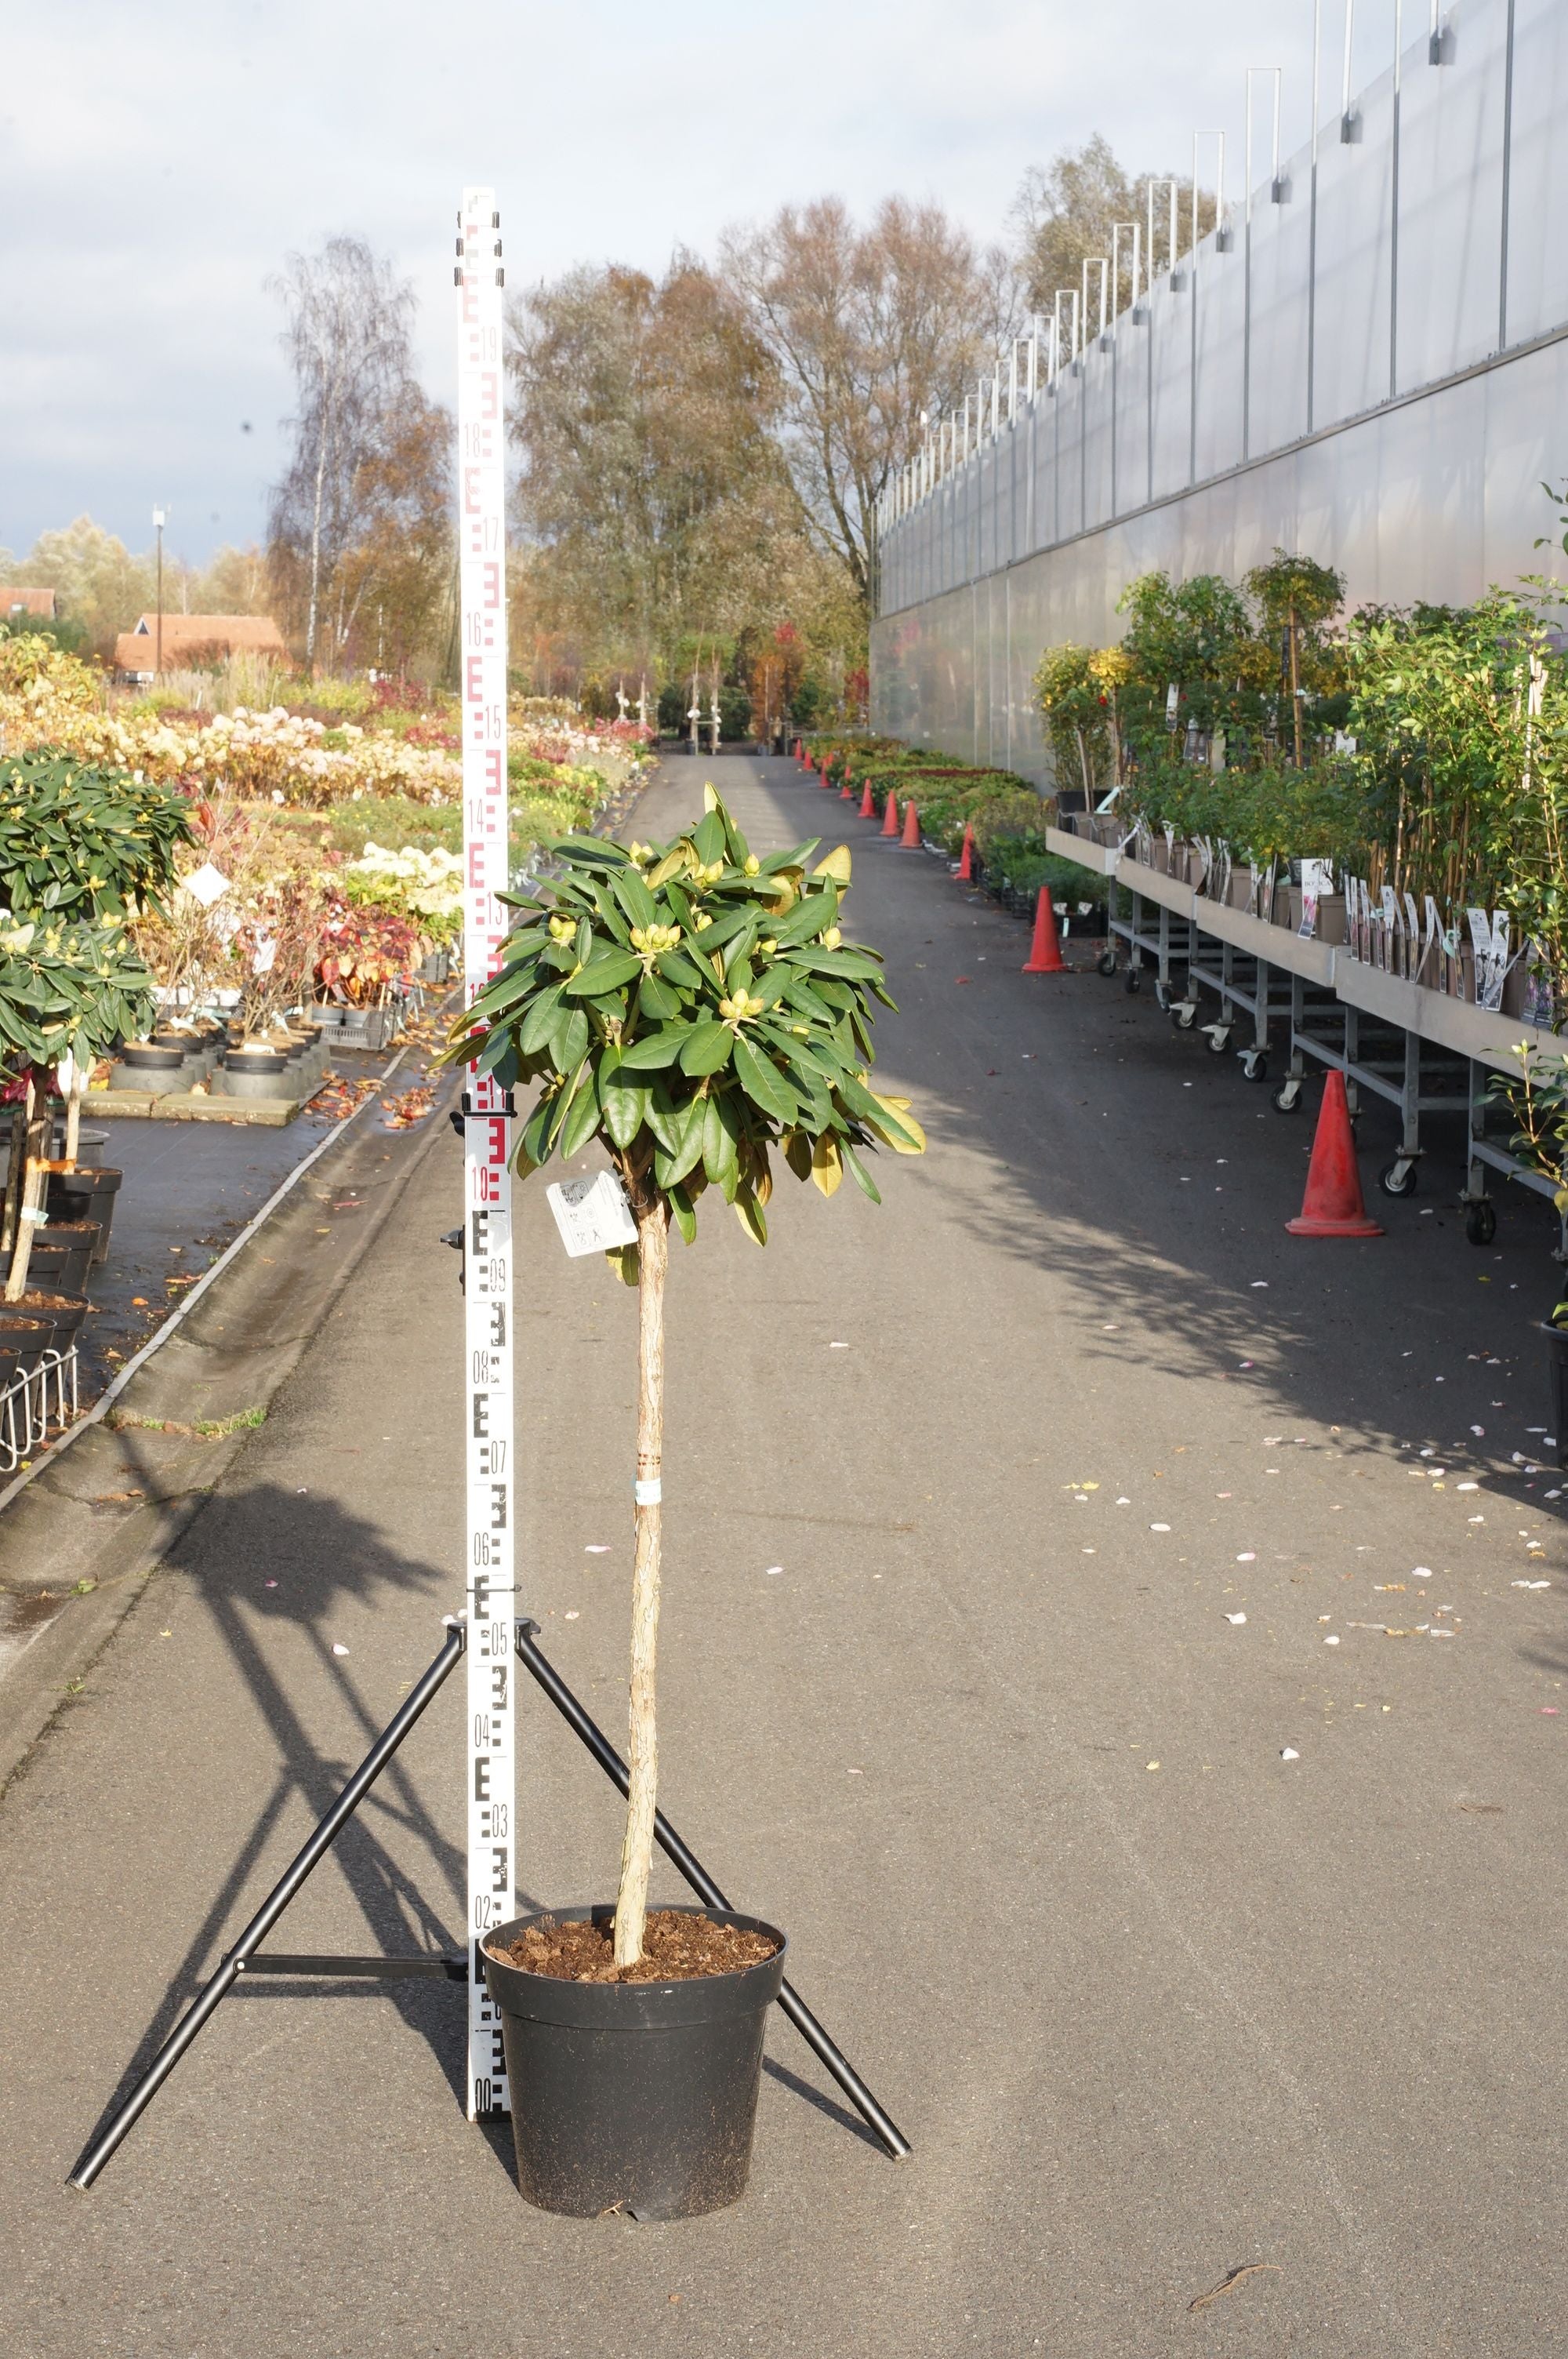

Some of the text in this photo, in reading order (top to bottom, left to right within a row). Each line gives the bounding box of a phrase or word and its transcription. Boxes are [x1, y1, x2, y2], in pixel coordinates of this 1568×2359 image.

[481, 326, 497, 362] 19
[463, 422, 481, 457] 18
[482, 518, 499, 553] 17
[466, 612, 482, 648] 16
[485, 704, 502, 740] 15
[469, 798, 485, 834] 14
[473, 1166, 488, 1201] 10
[490, 1258, 506, 1292] 09
[473, 1350, 489, 1383] 08
[491, 1440, 506, 1474] 07
[474, 1532, 489, 1565] 06
[492, 1622, 507, 1656] 05
[474, 1714, 490, 1747] 04
[492, 1804, 508, 1837] 03
[475, 1895, 491, 1929] 02
[475, 2078, 492, 2112] 00
